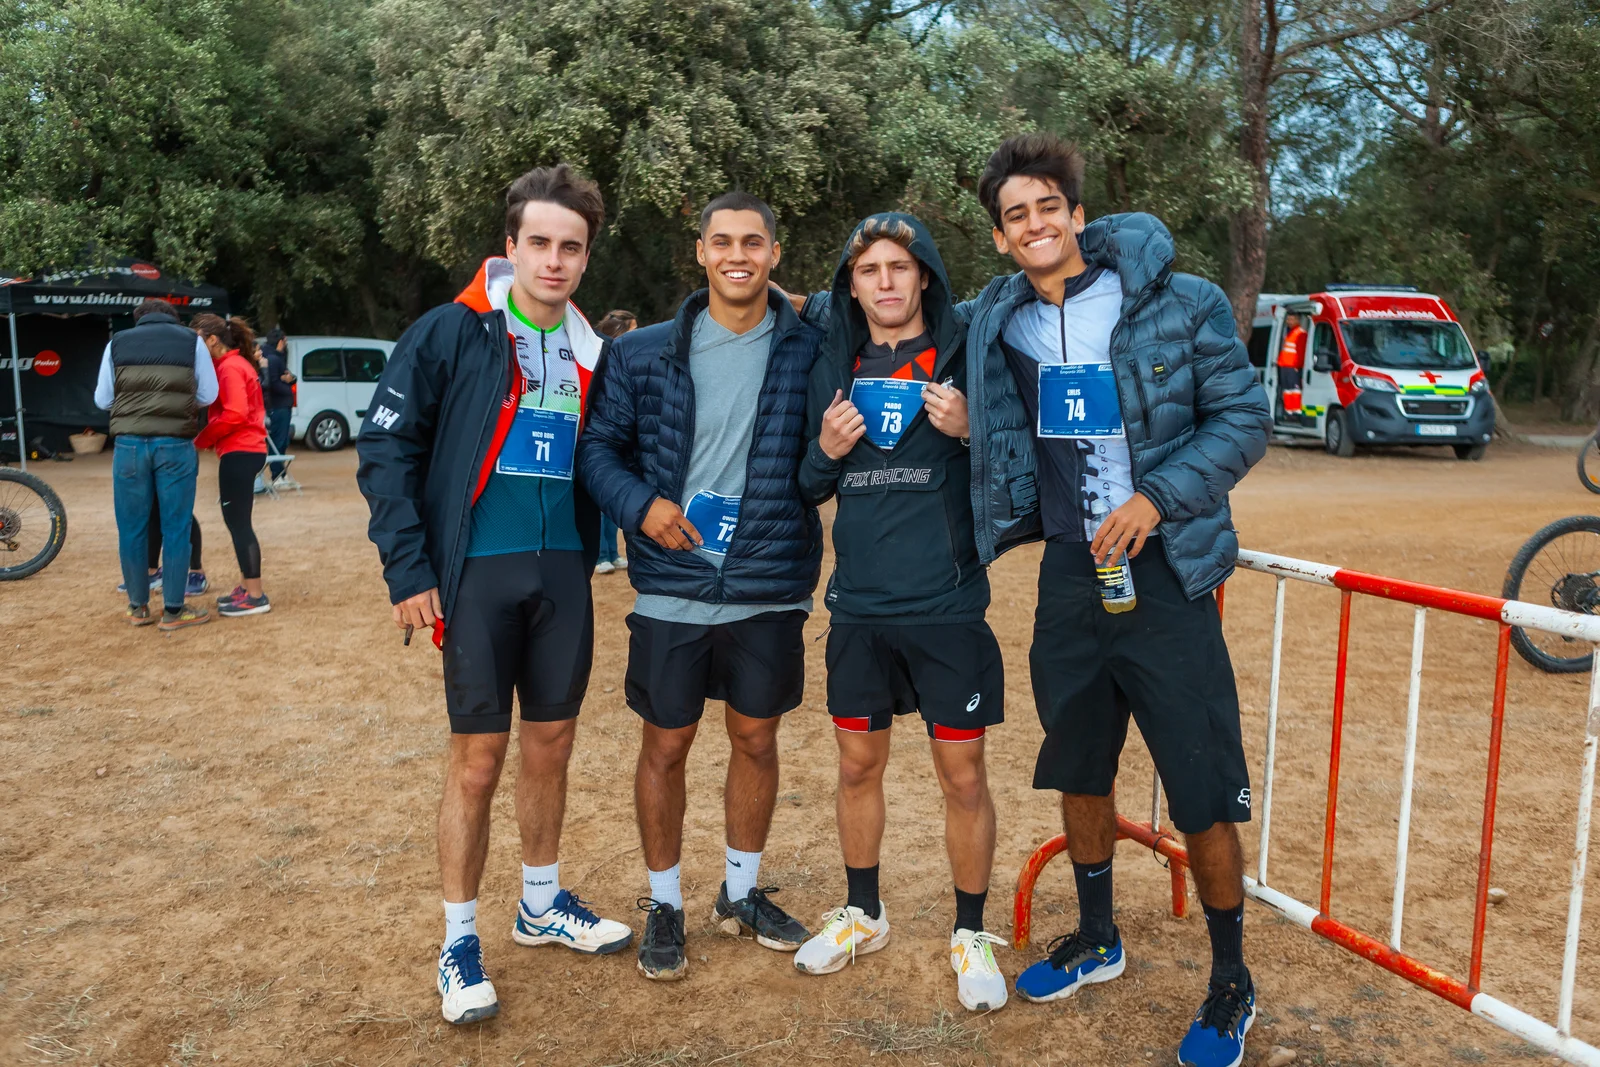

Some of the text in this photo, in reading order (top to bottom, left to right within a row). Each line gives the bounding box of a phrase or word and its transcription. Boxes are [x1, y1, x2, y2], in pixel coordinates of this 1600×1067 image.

[33, 292, 213, 307] www.bikingint.es
[884, 402, 902, 410] PARDO
[1064, 398, 1086, 421] 74
[372, 404, 400, 430] HH
[881, 411, 903, 434] 73
[534, 440, 550, 462] 71
[1099, 438, 1109, 473] SPO
[843, 468, 932, 488] FOX RACING
[717, 522, 736, 542] 72
[524, 879, 553, 887] adidas
